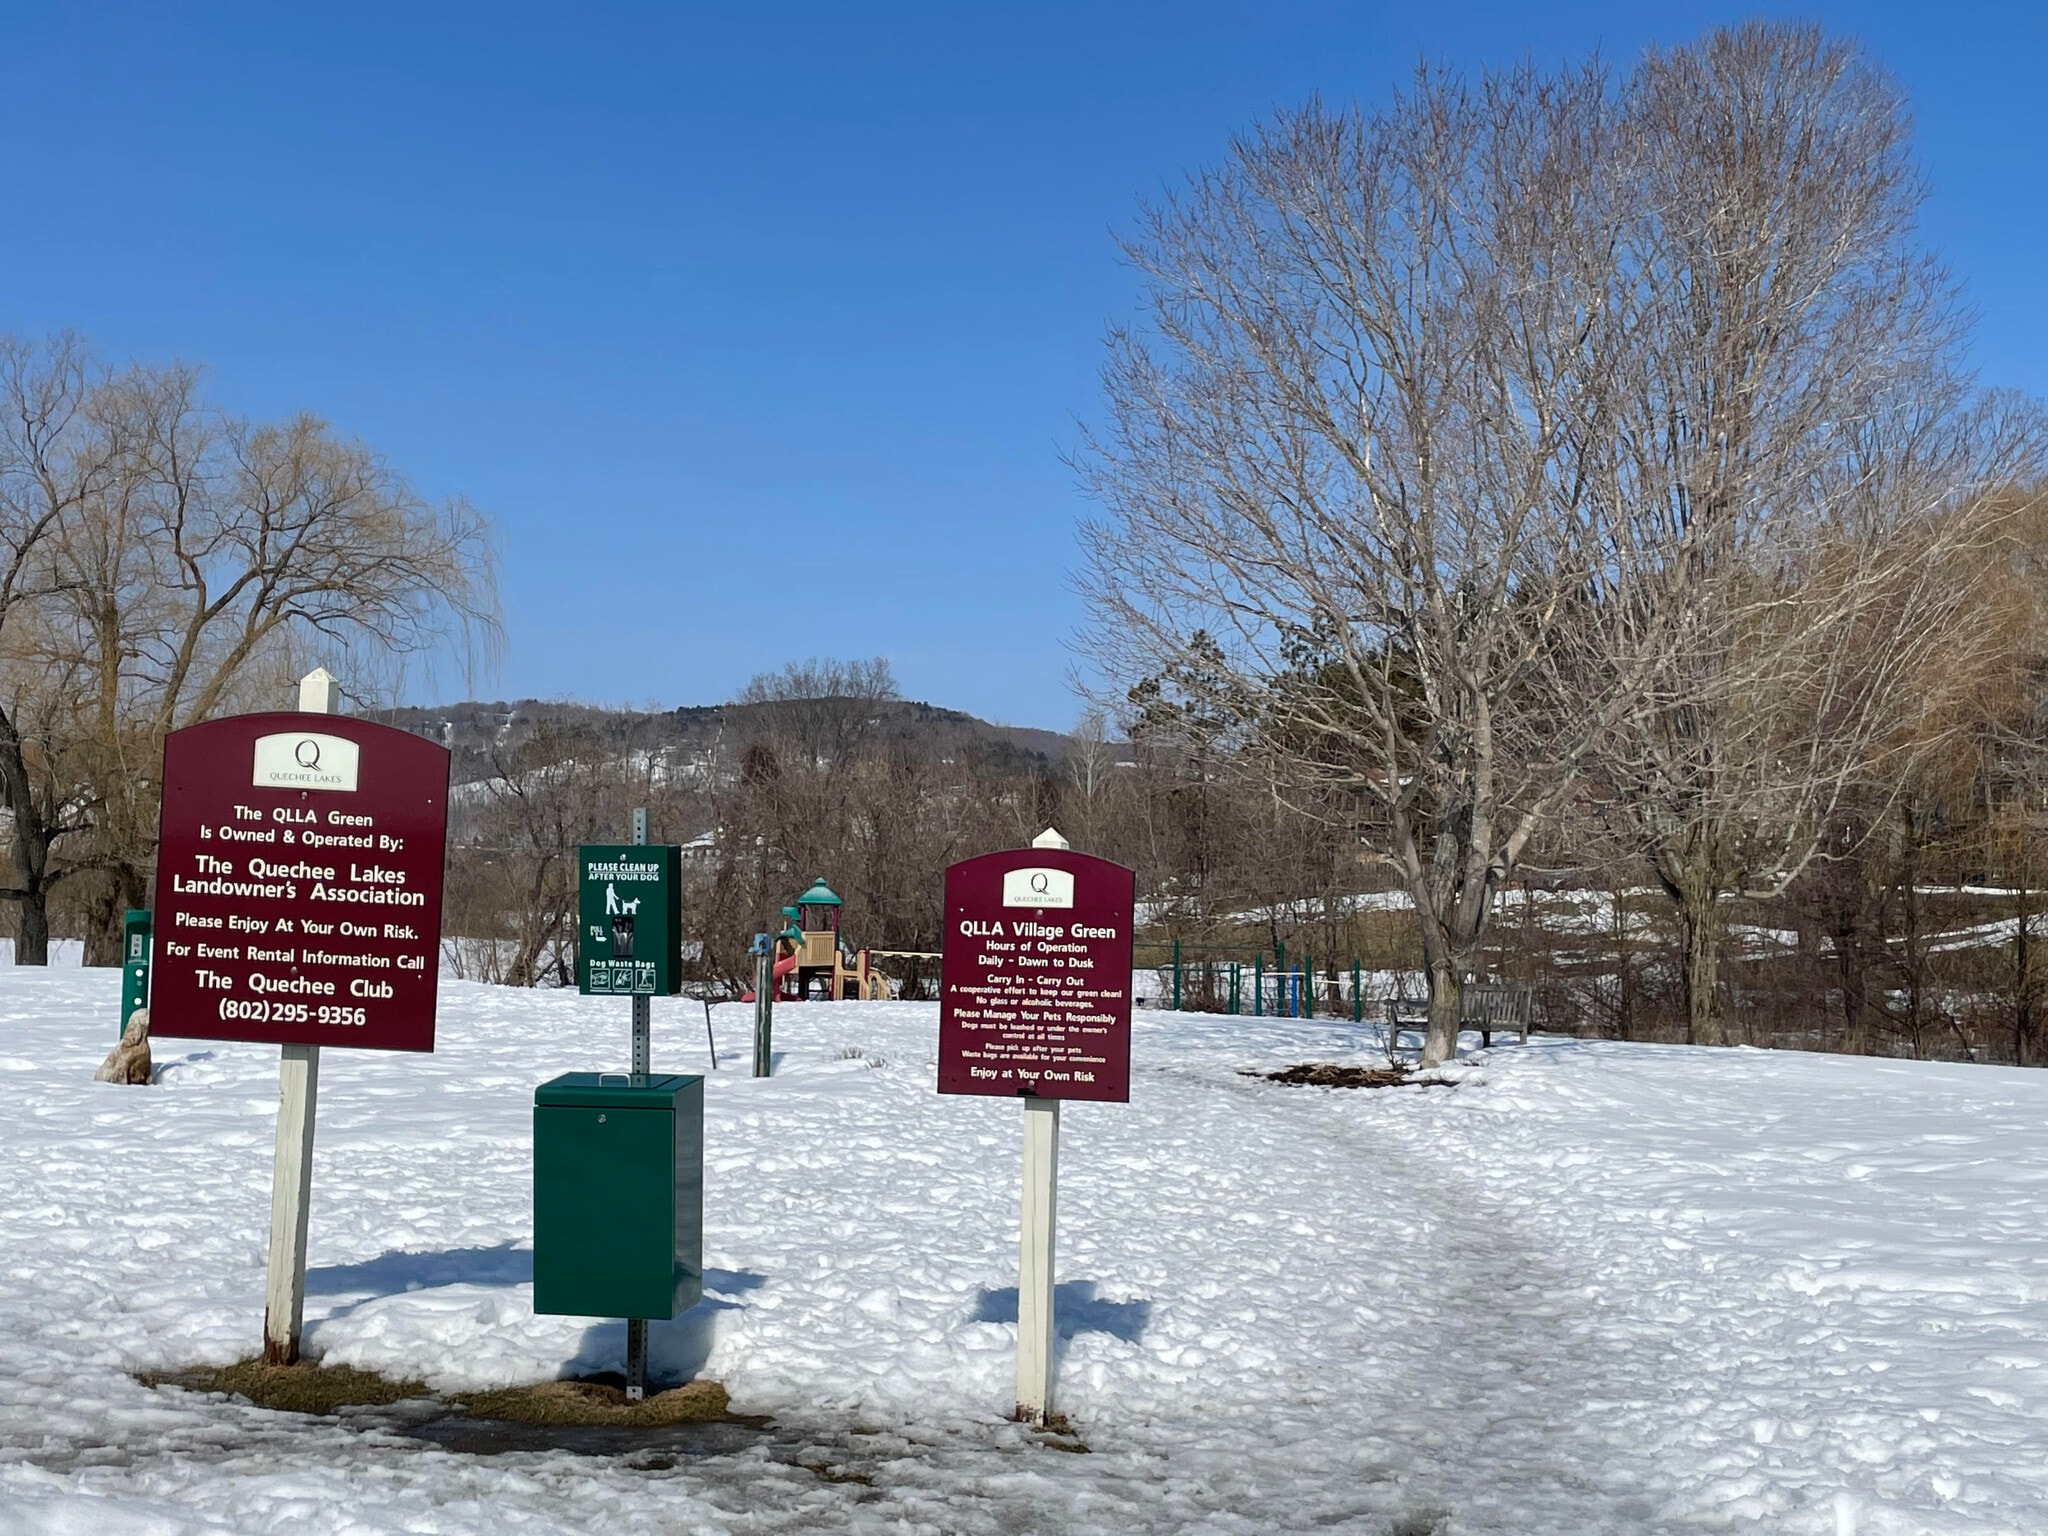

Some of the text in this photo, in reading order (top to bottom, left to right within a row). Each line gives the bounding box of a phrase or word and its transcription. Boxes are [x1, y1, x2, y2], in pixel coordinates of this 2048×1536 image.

[270, 772, 341, 783] QUECHEE LAKES
[234, 805, 372, 826] The QLLA Green
[201, 825, 404, 851] Is Owned & Operated By:
[196, 855, 405, 884] The Quechee Lakes
[588, 863, 618, 871] PLEASE
[620, 863, 646, 871] CLEAN
[174, 875, 424, 906] Landowner's Association
[176, 913, 418, 940] Please Enjoy At Your Own Risk.
[960, 921, 1115, 940] QLLA Village Green
[987, 940, 1087, 954] Hours of Operation
[167, 942, 424, 969] For Event Rental Information Call
[979, 955, 1004, 967] Daily
[1019, 957, 1048, 967] Dawn
[1053, 958, 1064, 967] to
[1069, 958, 1094, 968] Dusk
[590, 960, 606, 968] Dog
[635, 960, 655, 969] Bags
[196, 970, 393, 999] The Quechee Club
[987, 974, 1011, 985] Carry
[1016, 975, 1024, 984] In
[1037, 976, 1061, 987] Carry
[1066, 977, 1084, 986] Out
[960, 986, 1001, 994] cooperative
[1040, 988, 1058, 997] keep
[990, 997, 1008, 1006] glass
[1022, 998, 1052, 1006] alcoholic
[1055, 1000, 1094, 1009] beverages.
[219, 998, 366, 1026] (802)295-9356
[954, 1009, 1116, 1024] Please Manage Your Pets Responsibly
[962, 1022, 978, 1030] Dogs
[983, 1051, 997, 1059] bags
[1007, 1044, 1019, 1052] pick
[971, 1067, 1095, 1082] Enjoy at Your Own Risk
